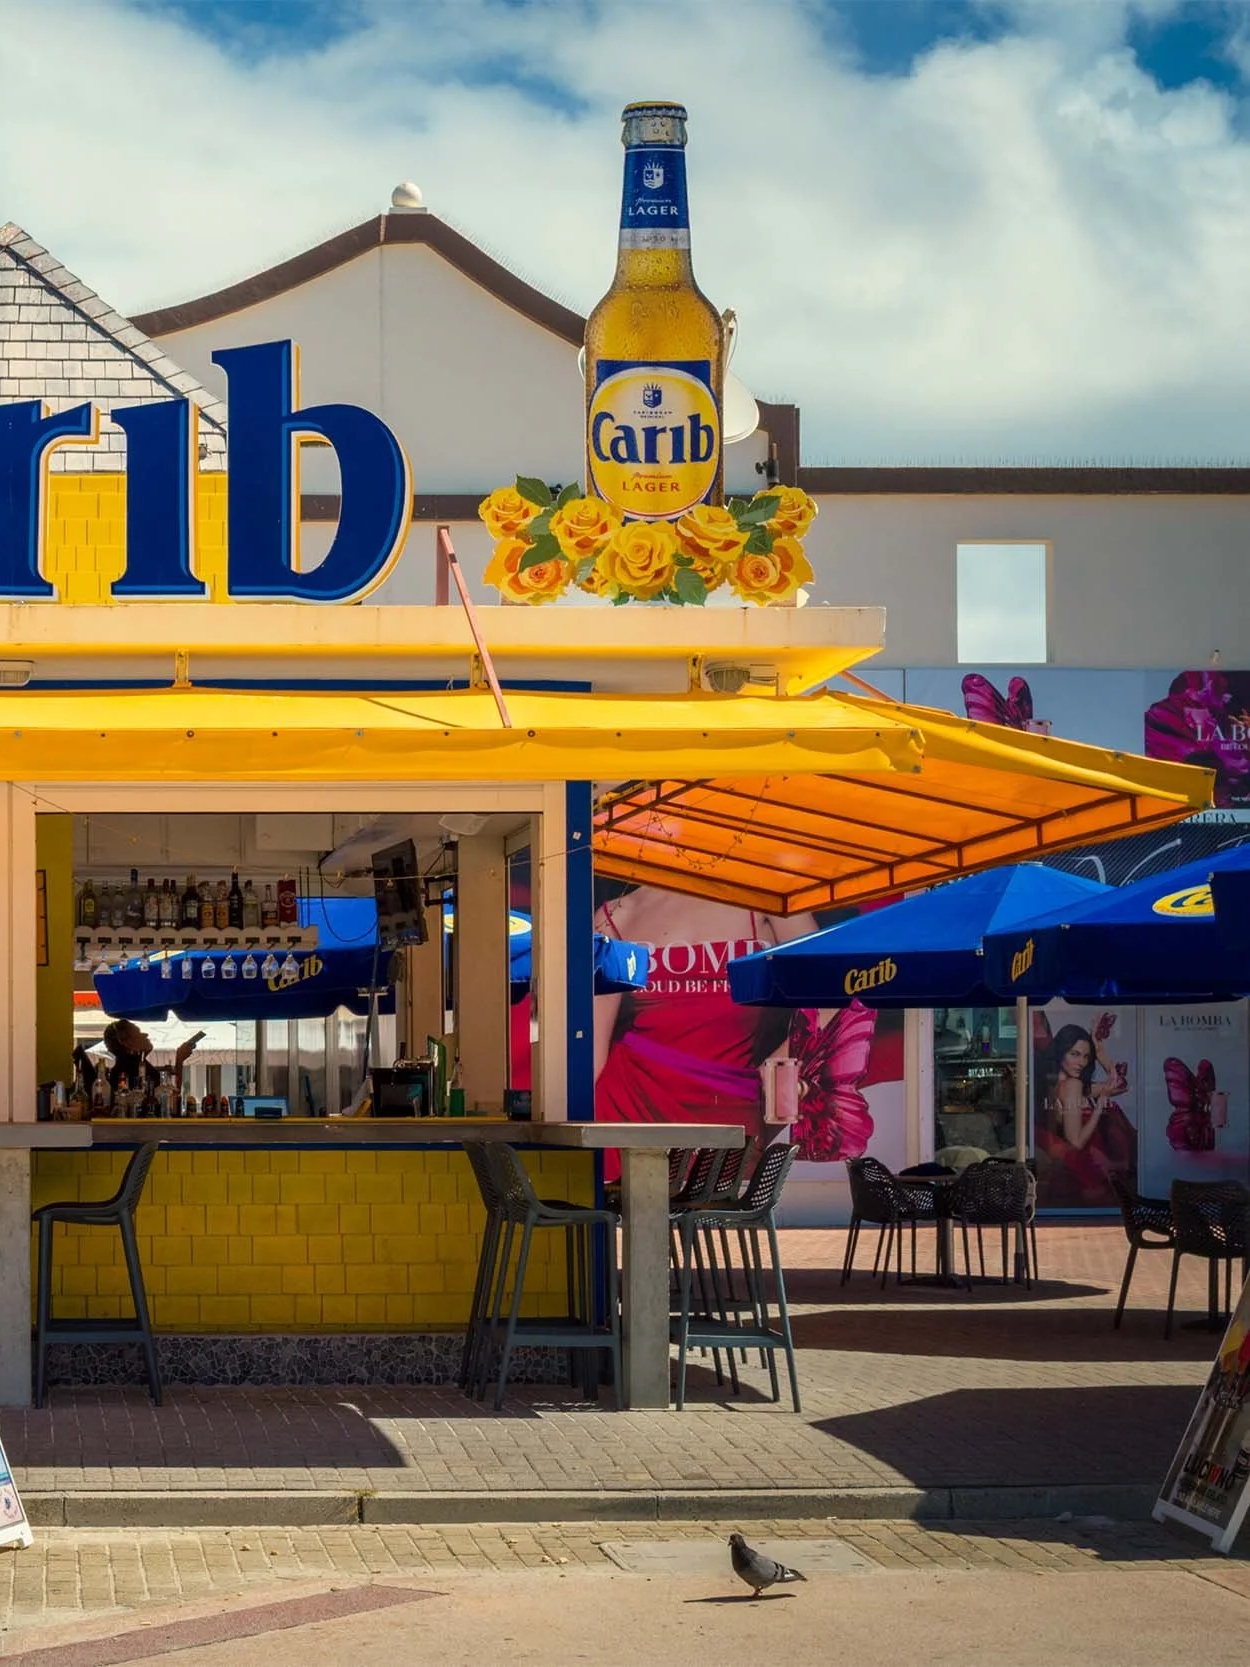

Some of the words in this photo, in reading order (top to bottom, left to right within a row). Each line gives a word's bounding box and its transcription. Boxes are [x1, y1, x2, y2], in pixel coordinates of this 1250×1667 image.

[628, 206, 679, 216] LAGER
[592, 411, 715, 464] Carib
[622, 481, 681, 492] LAGER
[1182, 812, 1238, 825] RERA
[636, 940, 764, 974] BOM
[844, 957, 898, 995] Carib
[636, 980, 680, 993] OUD
[685, 980, 708, 993] BE
